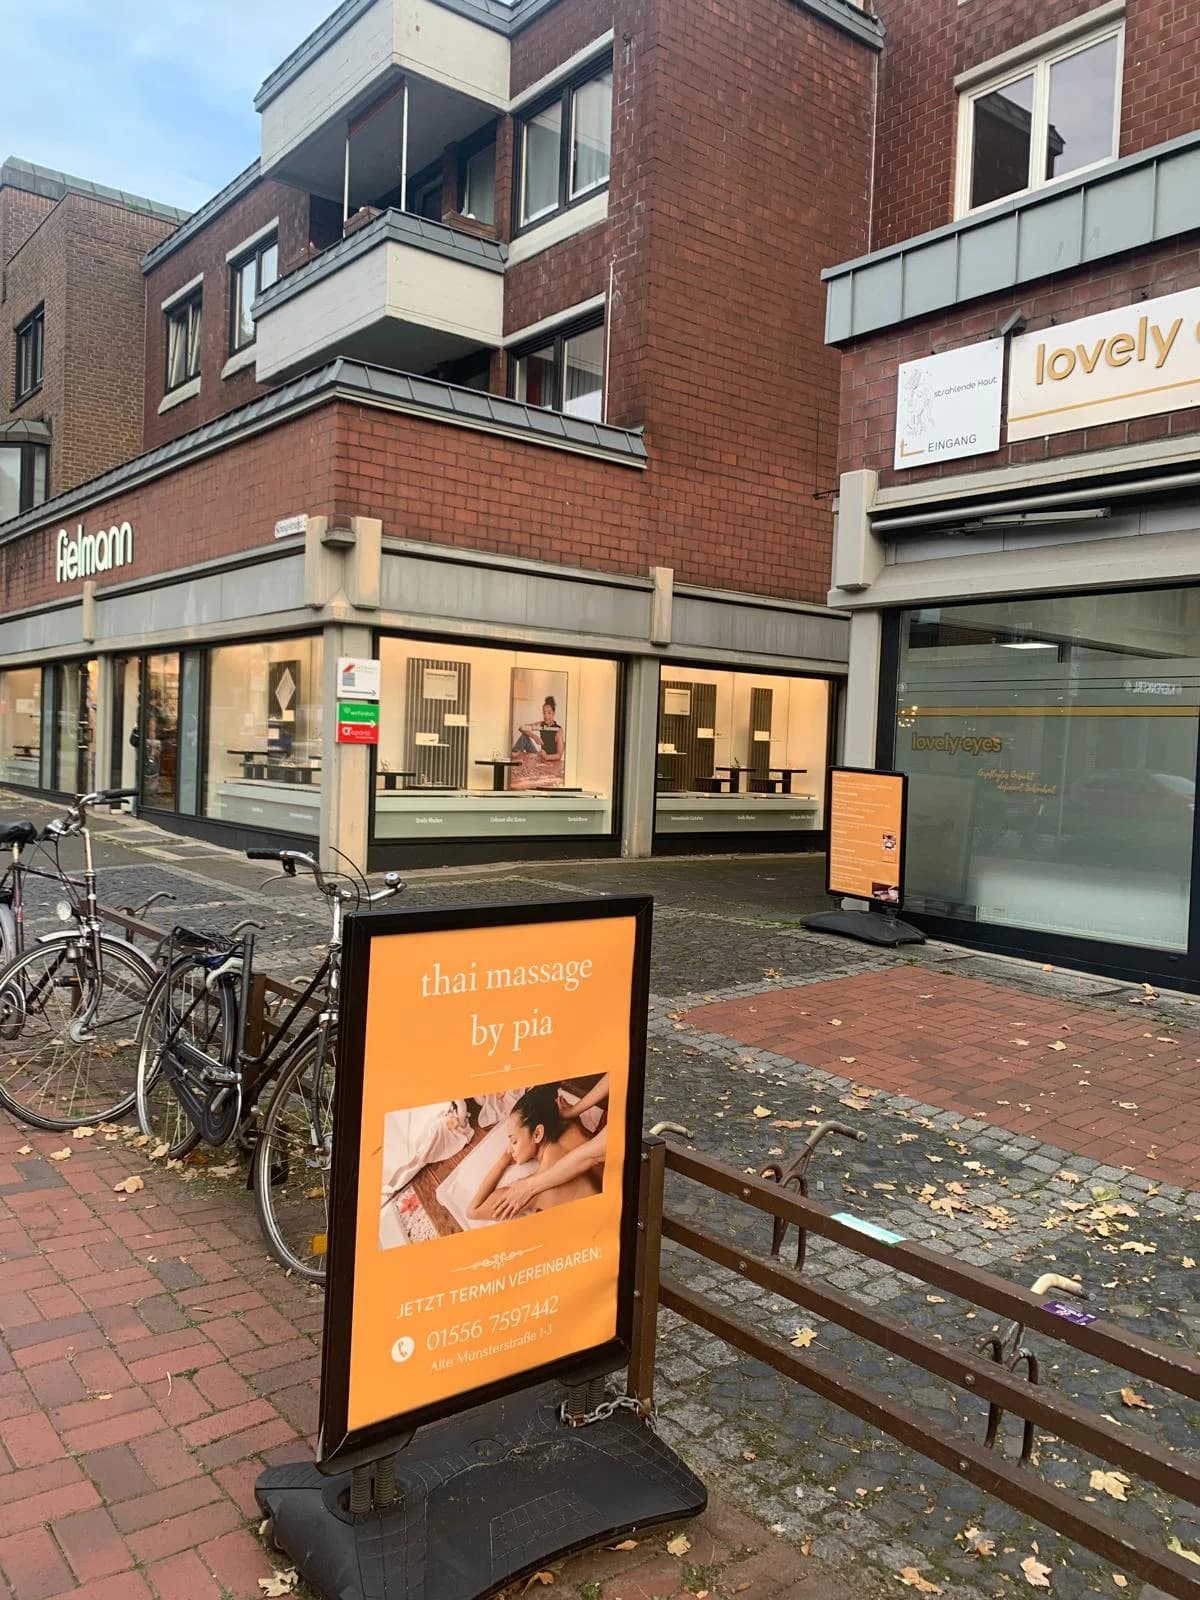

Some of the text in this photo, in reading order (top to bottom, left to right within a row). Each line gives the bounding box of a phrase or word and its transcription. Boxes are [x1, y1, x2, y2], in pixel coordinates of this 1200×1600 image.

[1035, 315, 1184, 385] lovely
[977, 376, 997, 388] Haut
[927, 433, 977, 453] EINGANG
[912, 732, 1001, 756] lovely eyes
[421, 958, 593, 998] thai massage
[471, 1008, 553, 1056] by pia
[396, 1292, 446, 1320] JETZT
[450, 1278, 506, 1305] TERMIN
[426, 1295, 560, 1351] 01556 7597442
[431, 1358, 454, 1372] Alte
